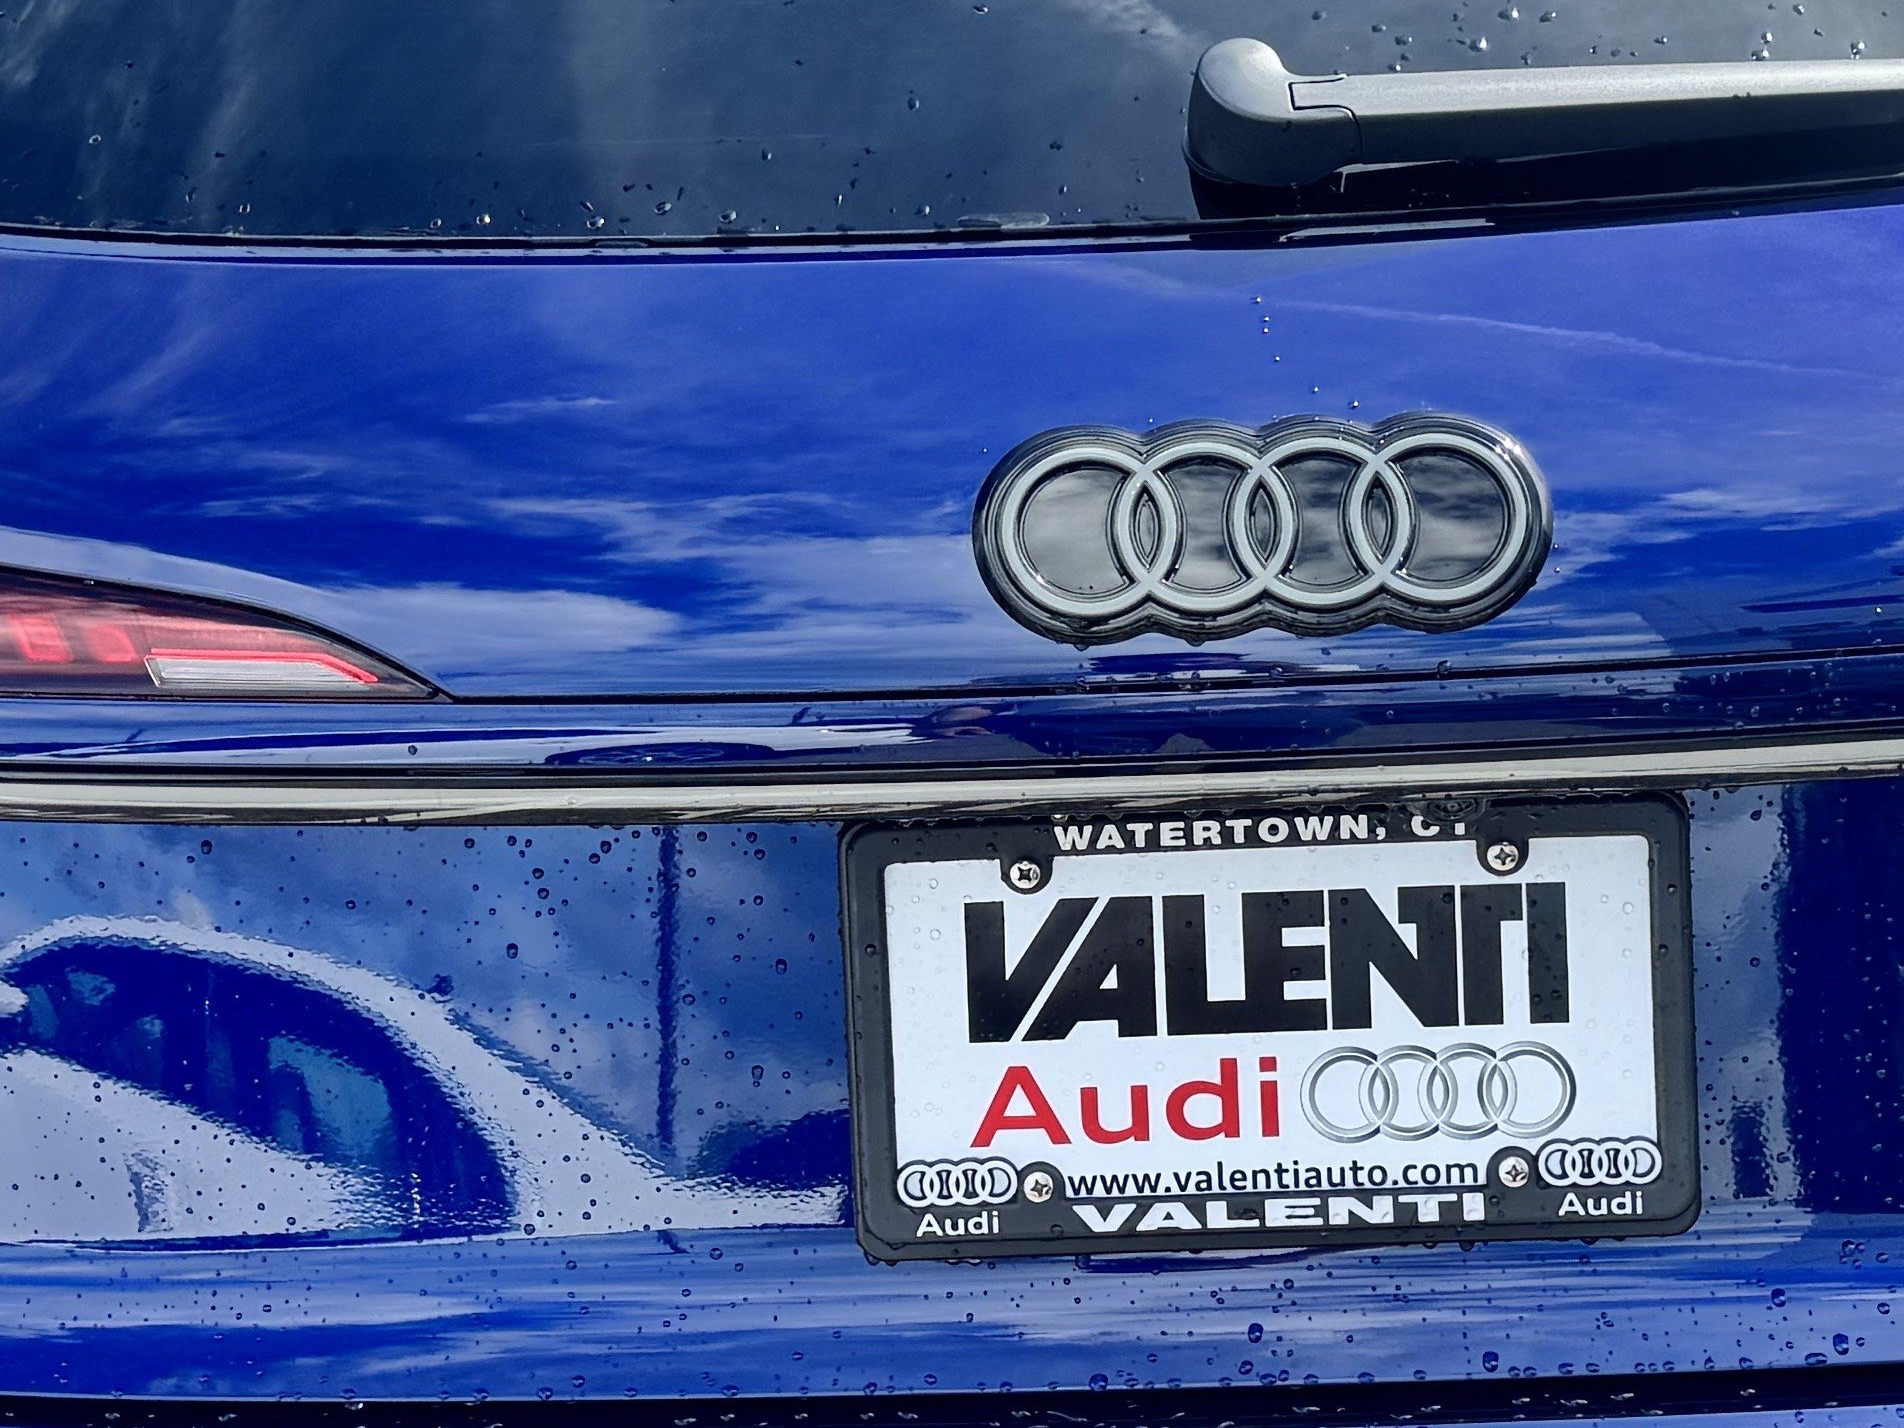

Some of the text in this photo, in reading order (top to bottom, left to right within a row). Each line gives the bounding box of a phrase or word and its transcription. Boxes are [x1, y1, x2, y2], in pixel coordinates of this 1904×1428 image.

[1052, 813, 1386, 852] WATERTOWN,
[964, 881, 1571, 1043] VALENTI
[970, 1056, 1281, 1148] Audi
[1068, 1158, 1479, 1197] www.valentiauto.com
[1070, 1192, 1487, 1234] VALENTI
[1557, 1190, 1644, 1217] Audi
[915, 1210, 1000, 1237] Audi
